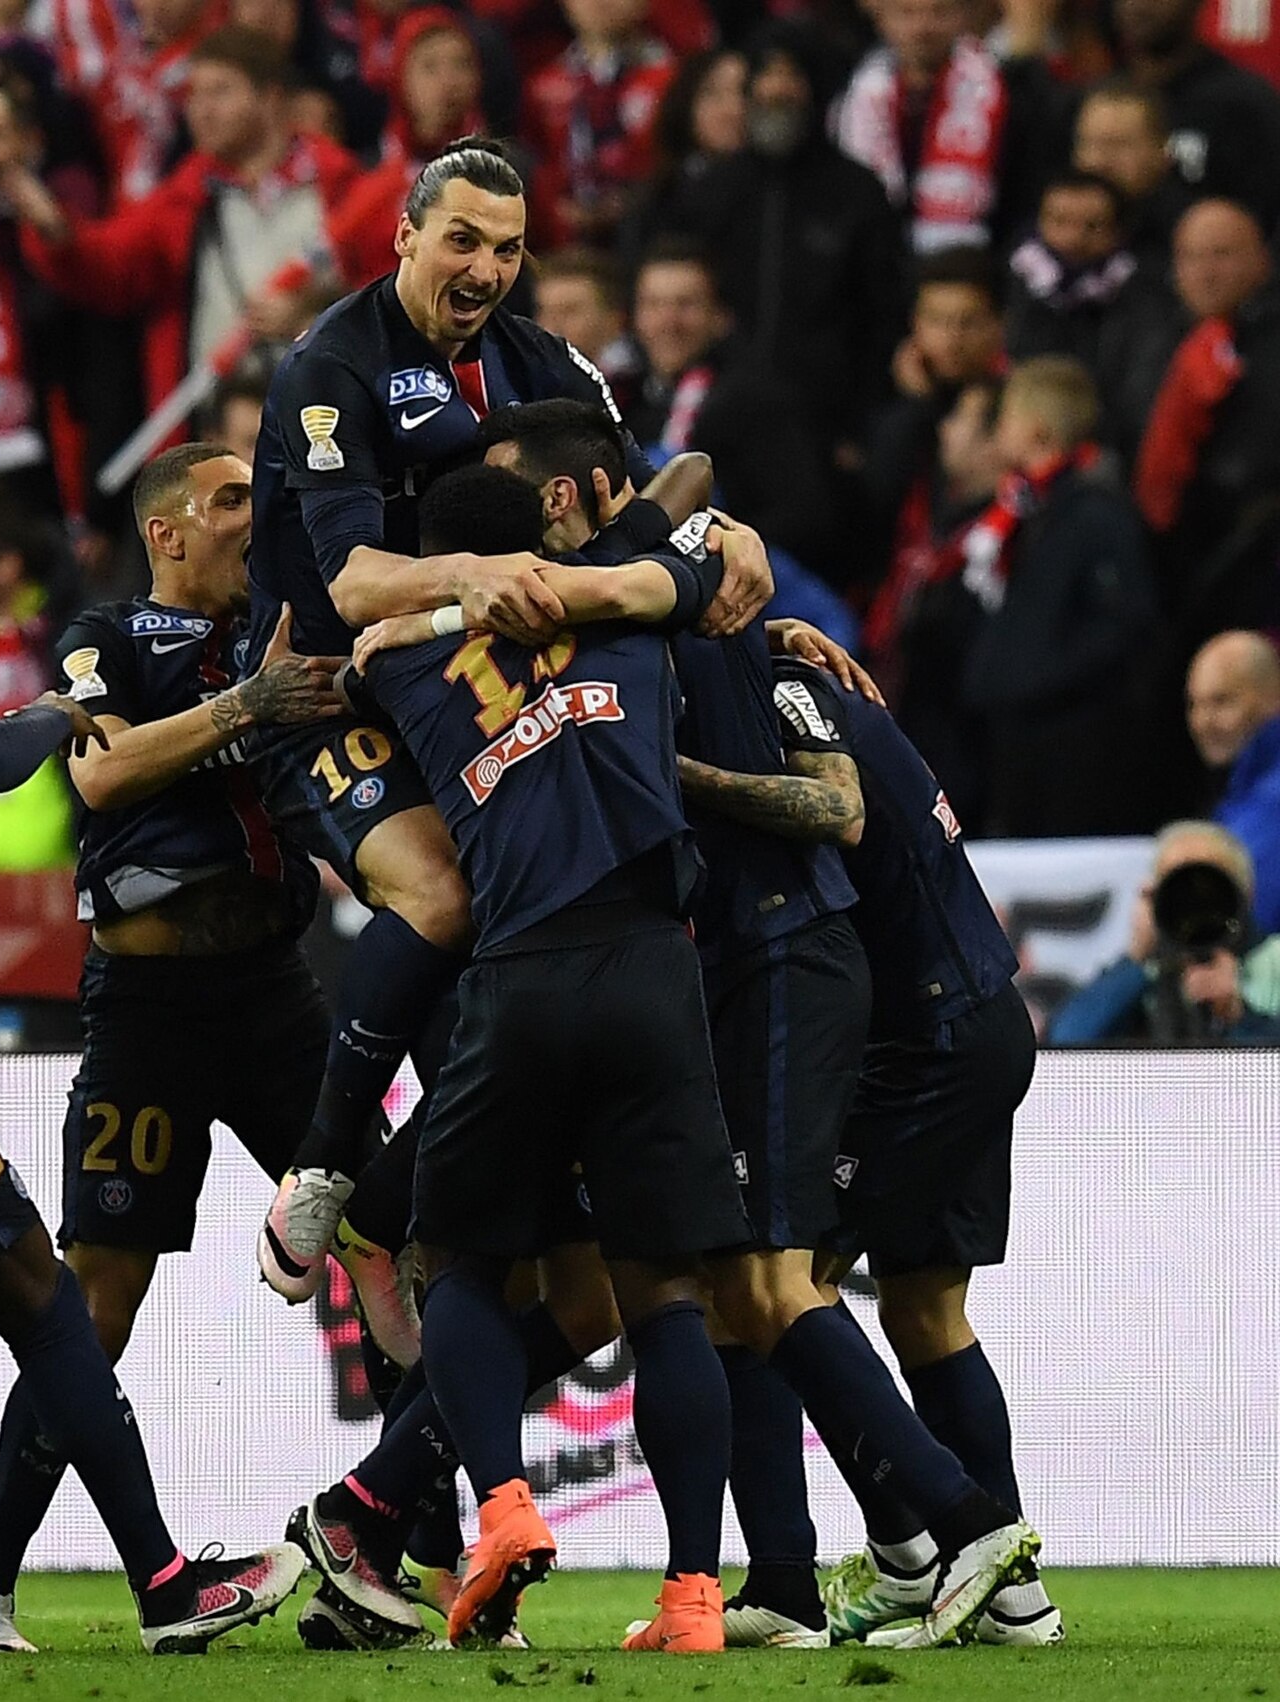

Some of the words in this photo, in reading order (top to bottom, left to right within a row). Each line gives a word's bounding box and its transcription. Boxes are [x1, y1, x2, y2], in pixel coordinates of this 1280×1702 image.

[390, 375, 417, 398] DJ
[133, 615, 172, 632] FDJ
[309, 727, 393, 803] 10
[82, 1102, 172, 1175] 20
